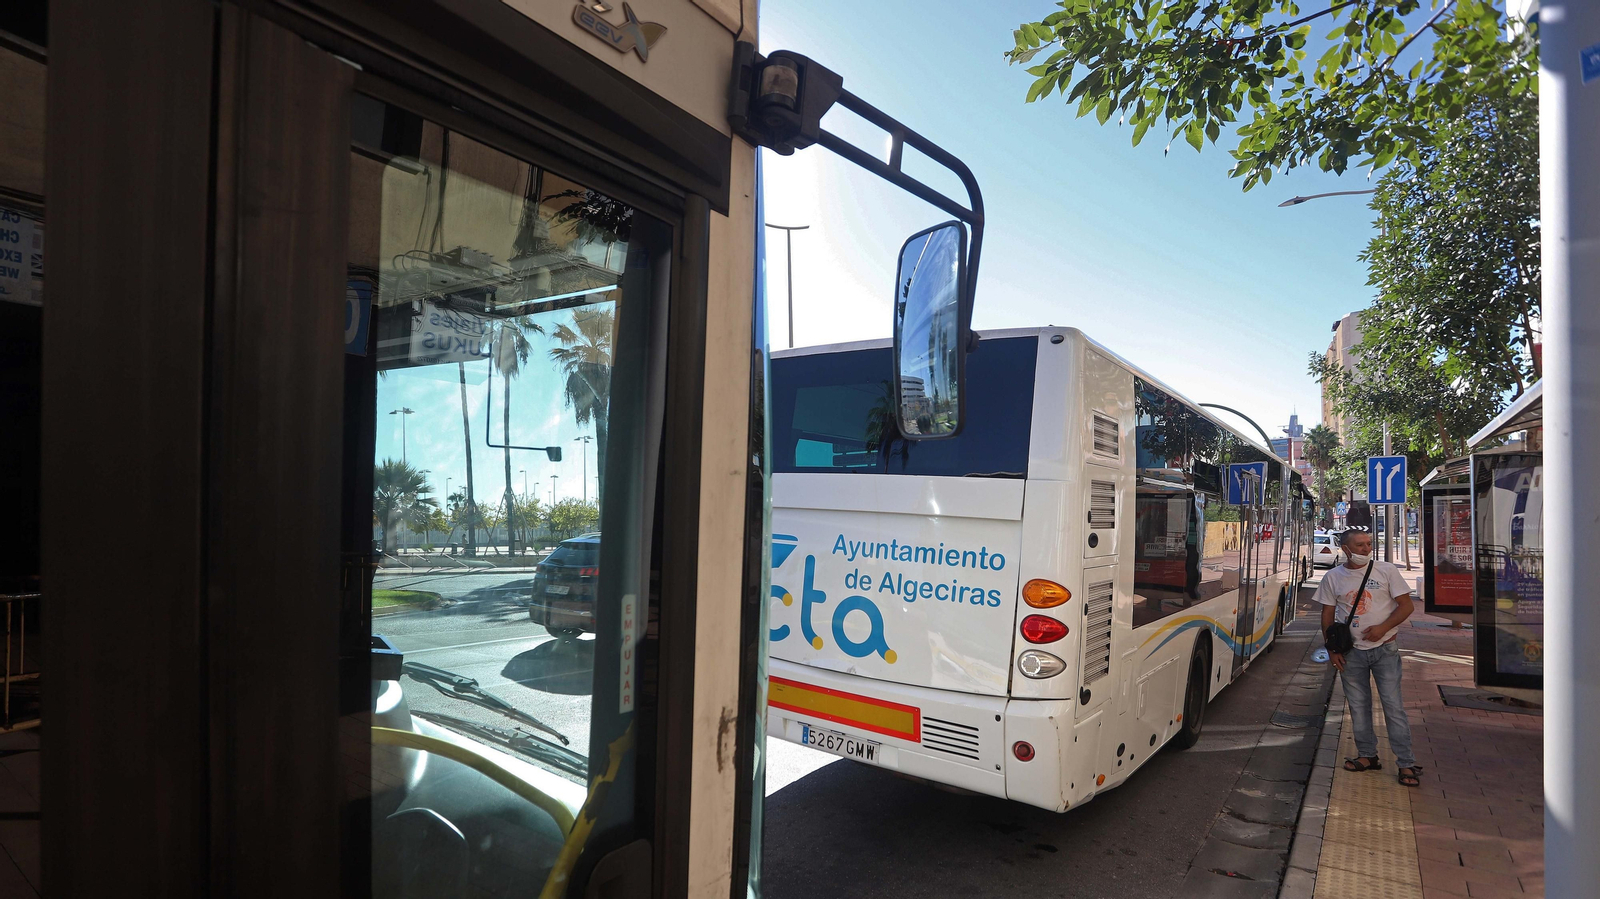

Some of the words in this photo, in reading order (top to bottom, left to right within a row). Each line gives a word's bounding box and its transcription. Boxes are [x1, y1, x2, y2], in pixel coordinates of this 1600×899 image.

[832, 534, 1006, 571] Ayuntamiento
[845, 568, 872, 591] de
[878, 572, 1001, 608] Algeciras
[623, 603, 633, 705] EMPUJAR
